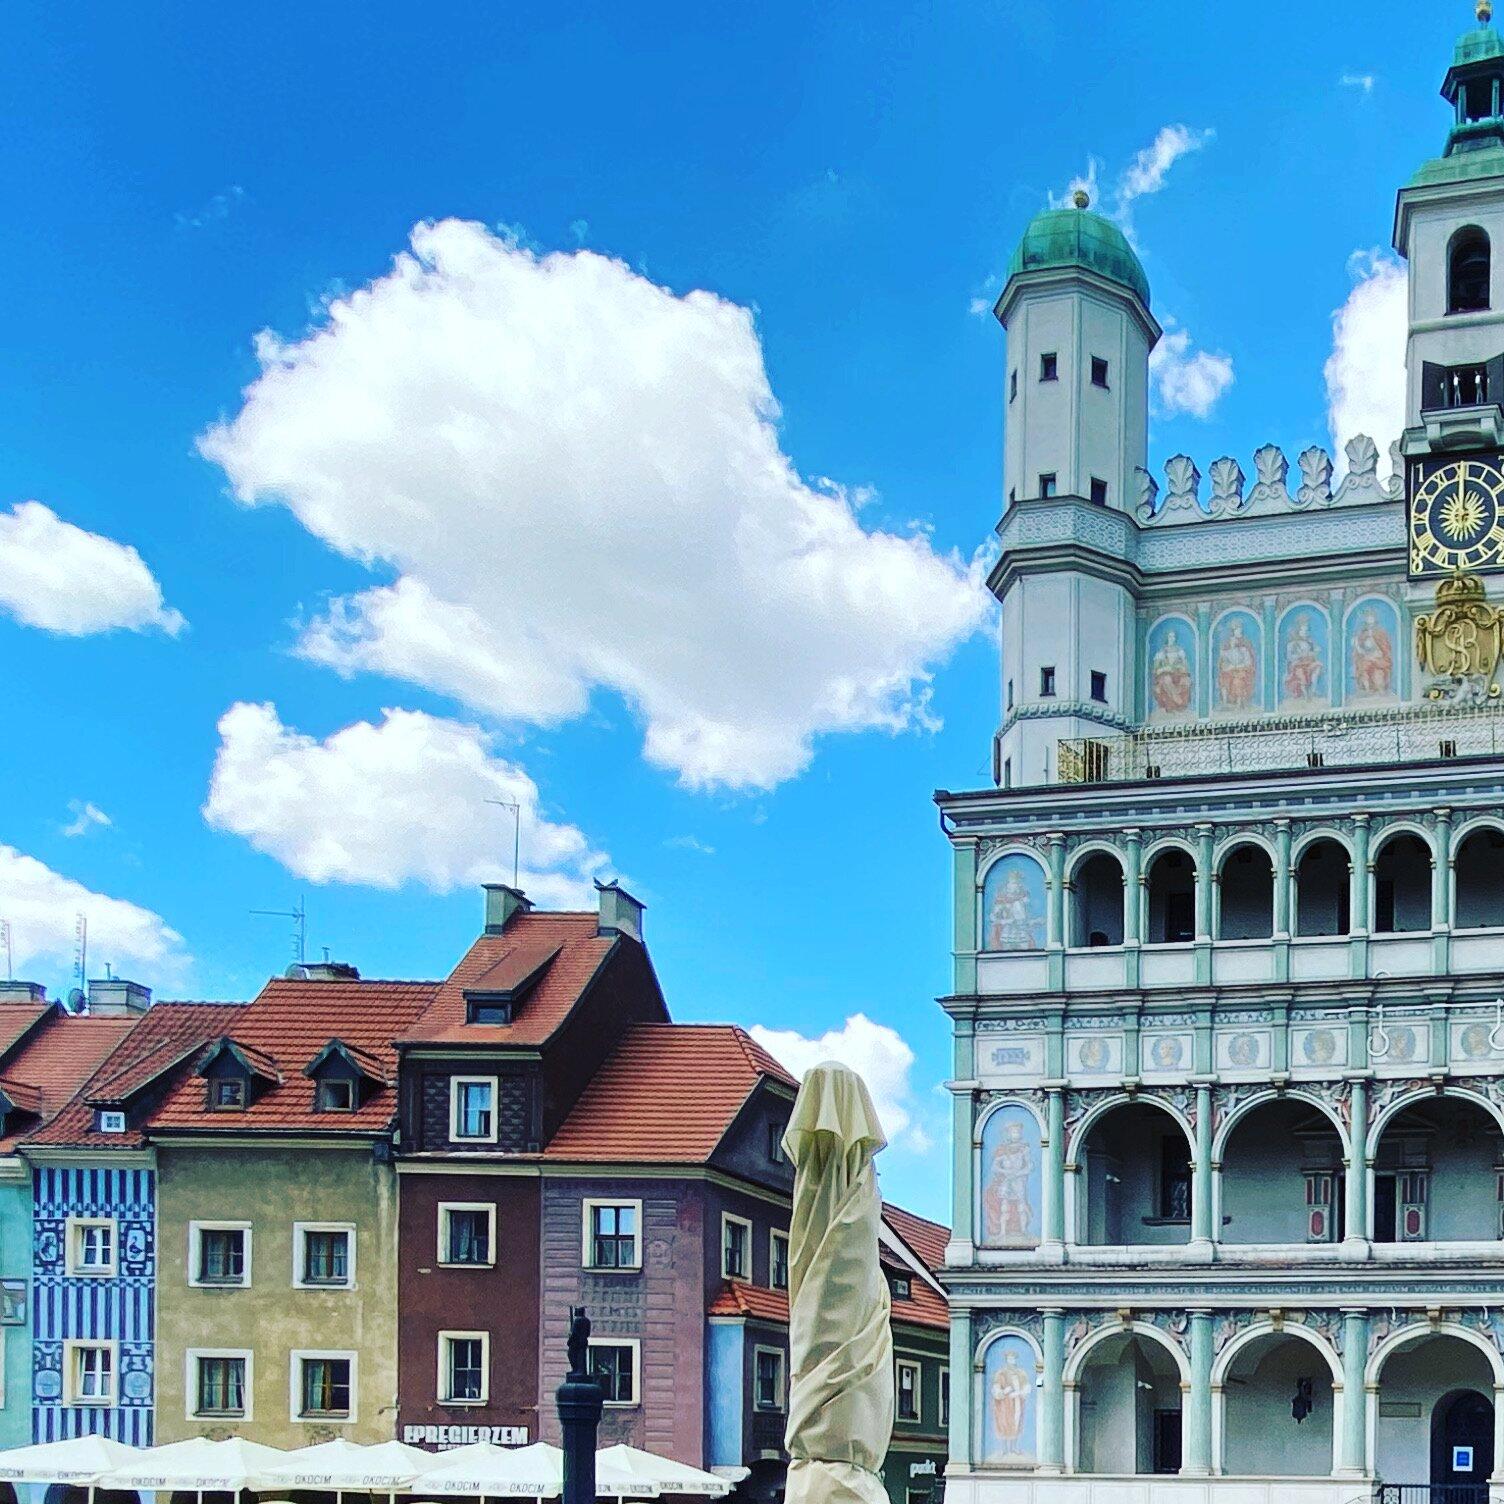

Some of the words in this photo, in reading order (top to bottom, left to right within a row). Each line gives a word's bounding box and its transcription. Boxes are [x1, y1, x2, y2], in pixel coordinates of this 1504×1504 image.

[1415, 462, 1424, 483] 1
[1411, 549, 1426, 573] 8
[294, 1474, 332, 1485] OKOCIM
[444, 1481, 480, 1492] OKOCIM
[509, 1482, 546, 1494] OKOCIM
